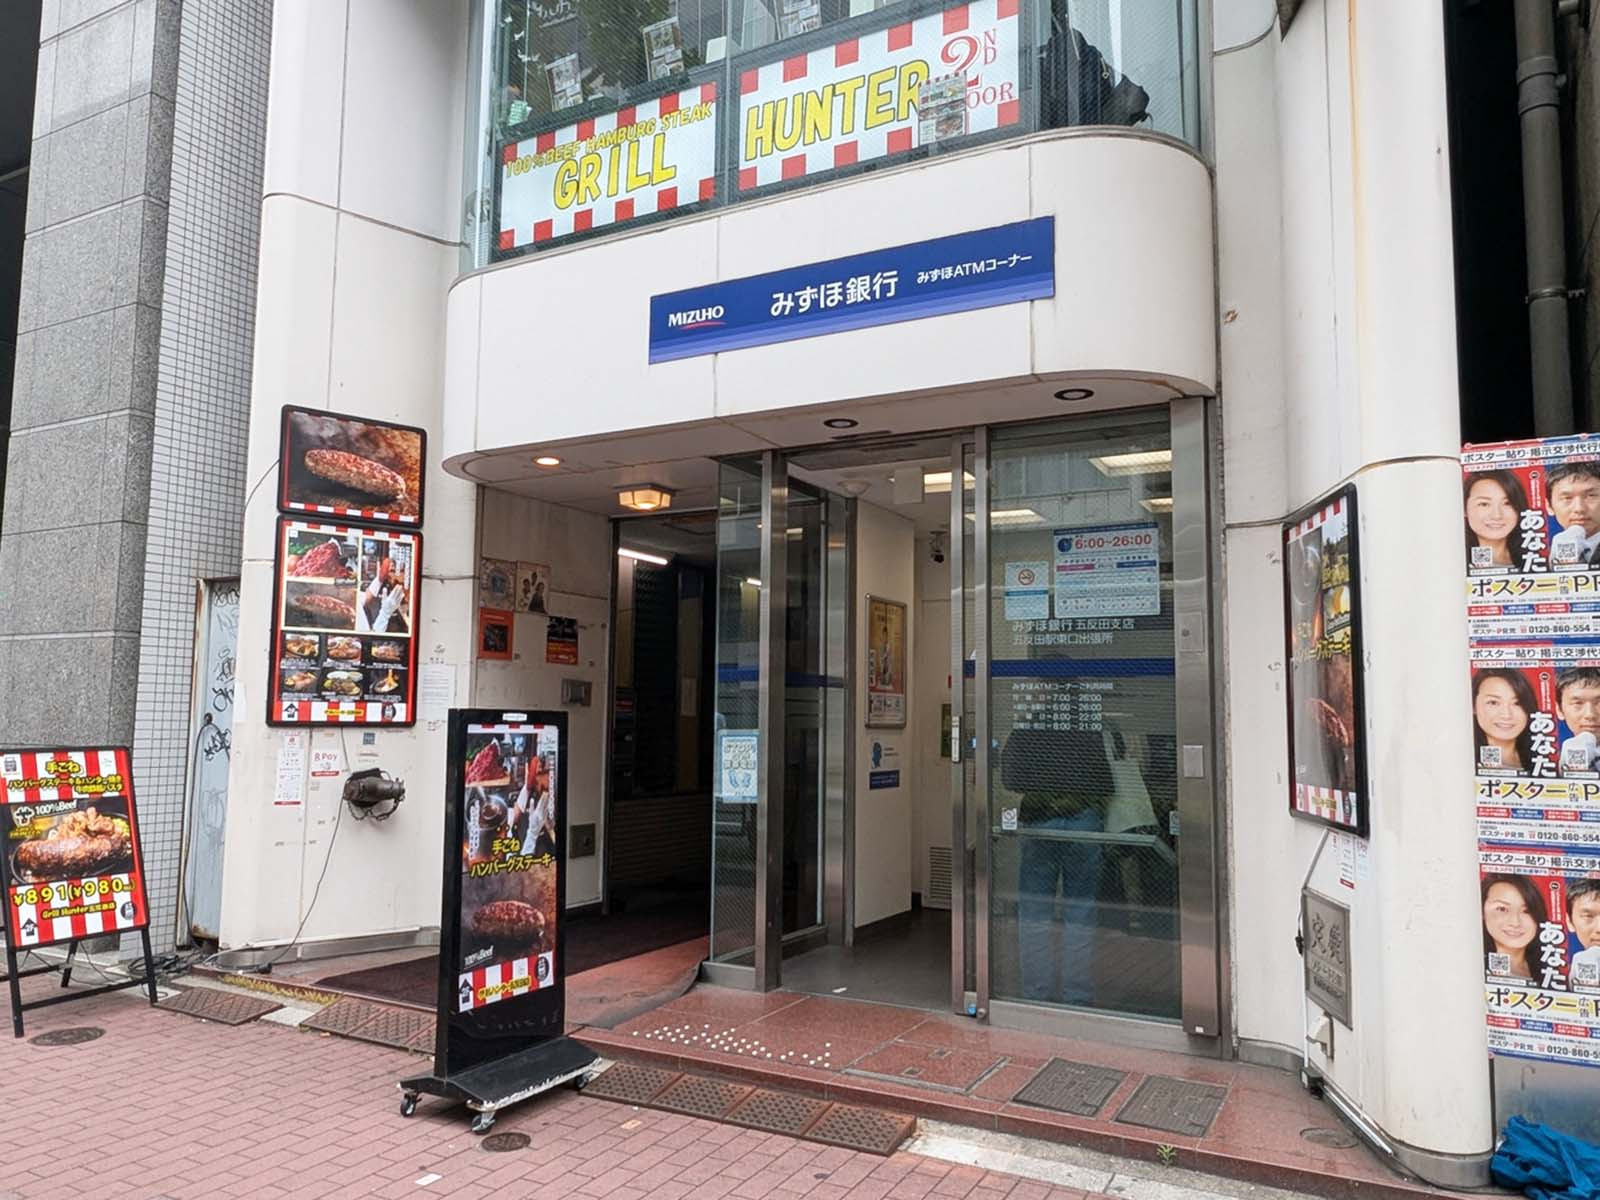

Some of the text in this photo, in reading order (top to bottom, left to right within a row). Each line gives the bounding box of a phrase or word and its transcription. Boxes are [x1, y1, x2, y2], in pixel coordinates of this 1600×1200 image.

[745, 60, 929, 162] HUNTER
[505, 101, 713, 177] 100%BEEF HAMBURG STEAK
[553, 132, 678, 210] GRILL
[916, 253, 1033, 285] みずほATMコーナー
[769, 269, 899, 318] みずほ銀行
[668, 304, 724, 328] MIZUHO
[1463, 442, 1600, 464] ポスター貼り・掲示交渉代行
[1520, 508, 1547, 573] あなた
[1471, 577, 1557, 598] ポスター
[1528, 623, 1591, 634] 0120-860-554
[1529, 711, 1557, 778] あなた
[46, 761, 81, 775] 手こね
[1479, 780, 1567, 799] ポスター
[34, 799, 77, 816] 100%Beef
[492, 838, 520, 856] 手こね
[469, 853, 553, 879] ハンバーグステーキ
[1481, 853, 1600, 869] ポスター貼り・掲示交渉
[1538, 921, 1567, 991] あなた
[1488, 987, 1578, 1012] ポスター
